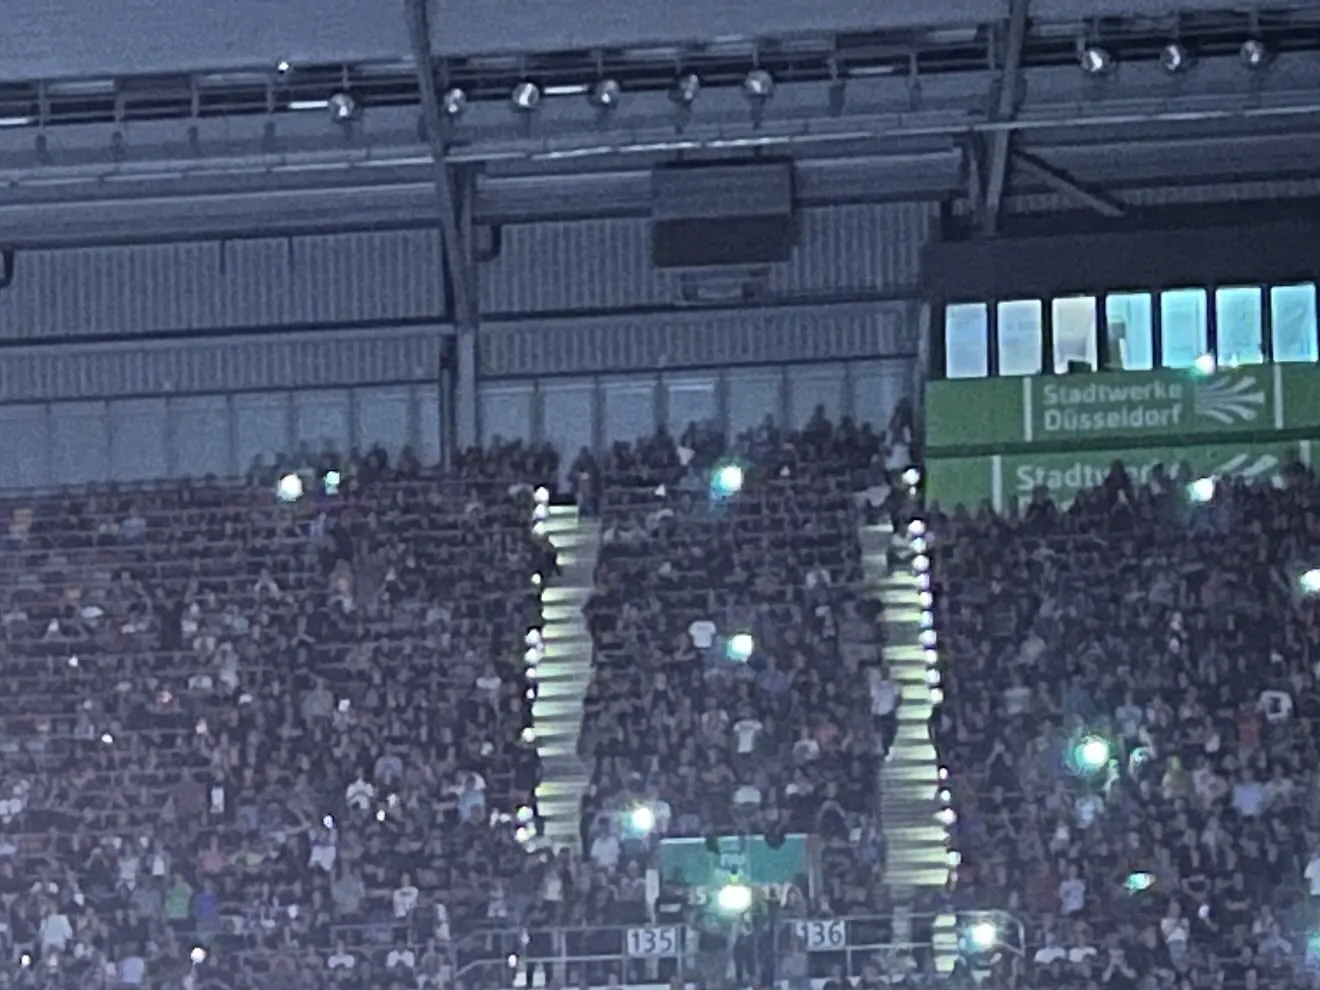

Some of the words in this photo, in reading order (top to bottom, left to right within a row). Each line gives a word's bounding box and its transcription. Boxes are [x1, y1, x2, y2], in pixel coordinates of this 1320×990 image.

[1043, 381, 1182, 405] Stadtwerke
[1044, 405, 1183, 432] Düsseldorf
[630, 930, 673, 954] 135
[799, 920, 843, 946] 136
